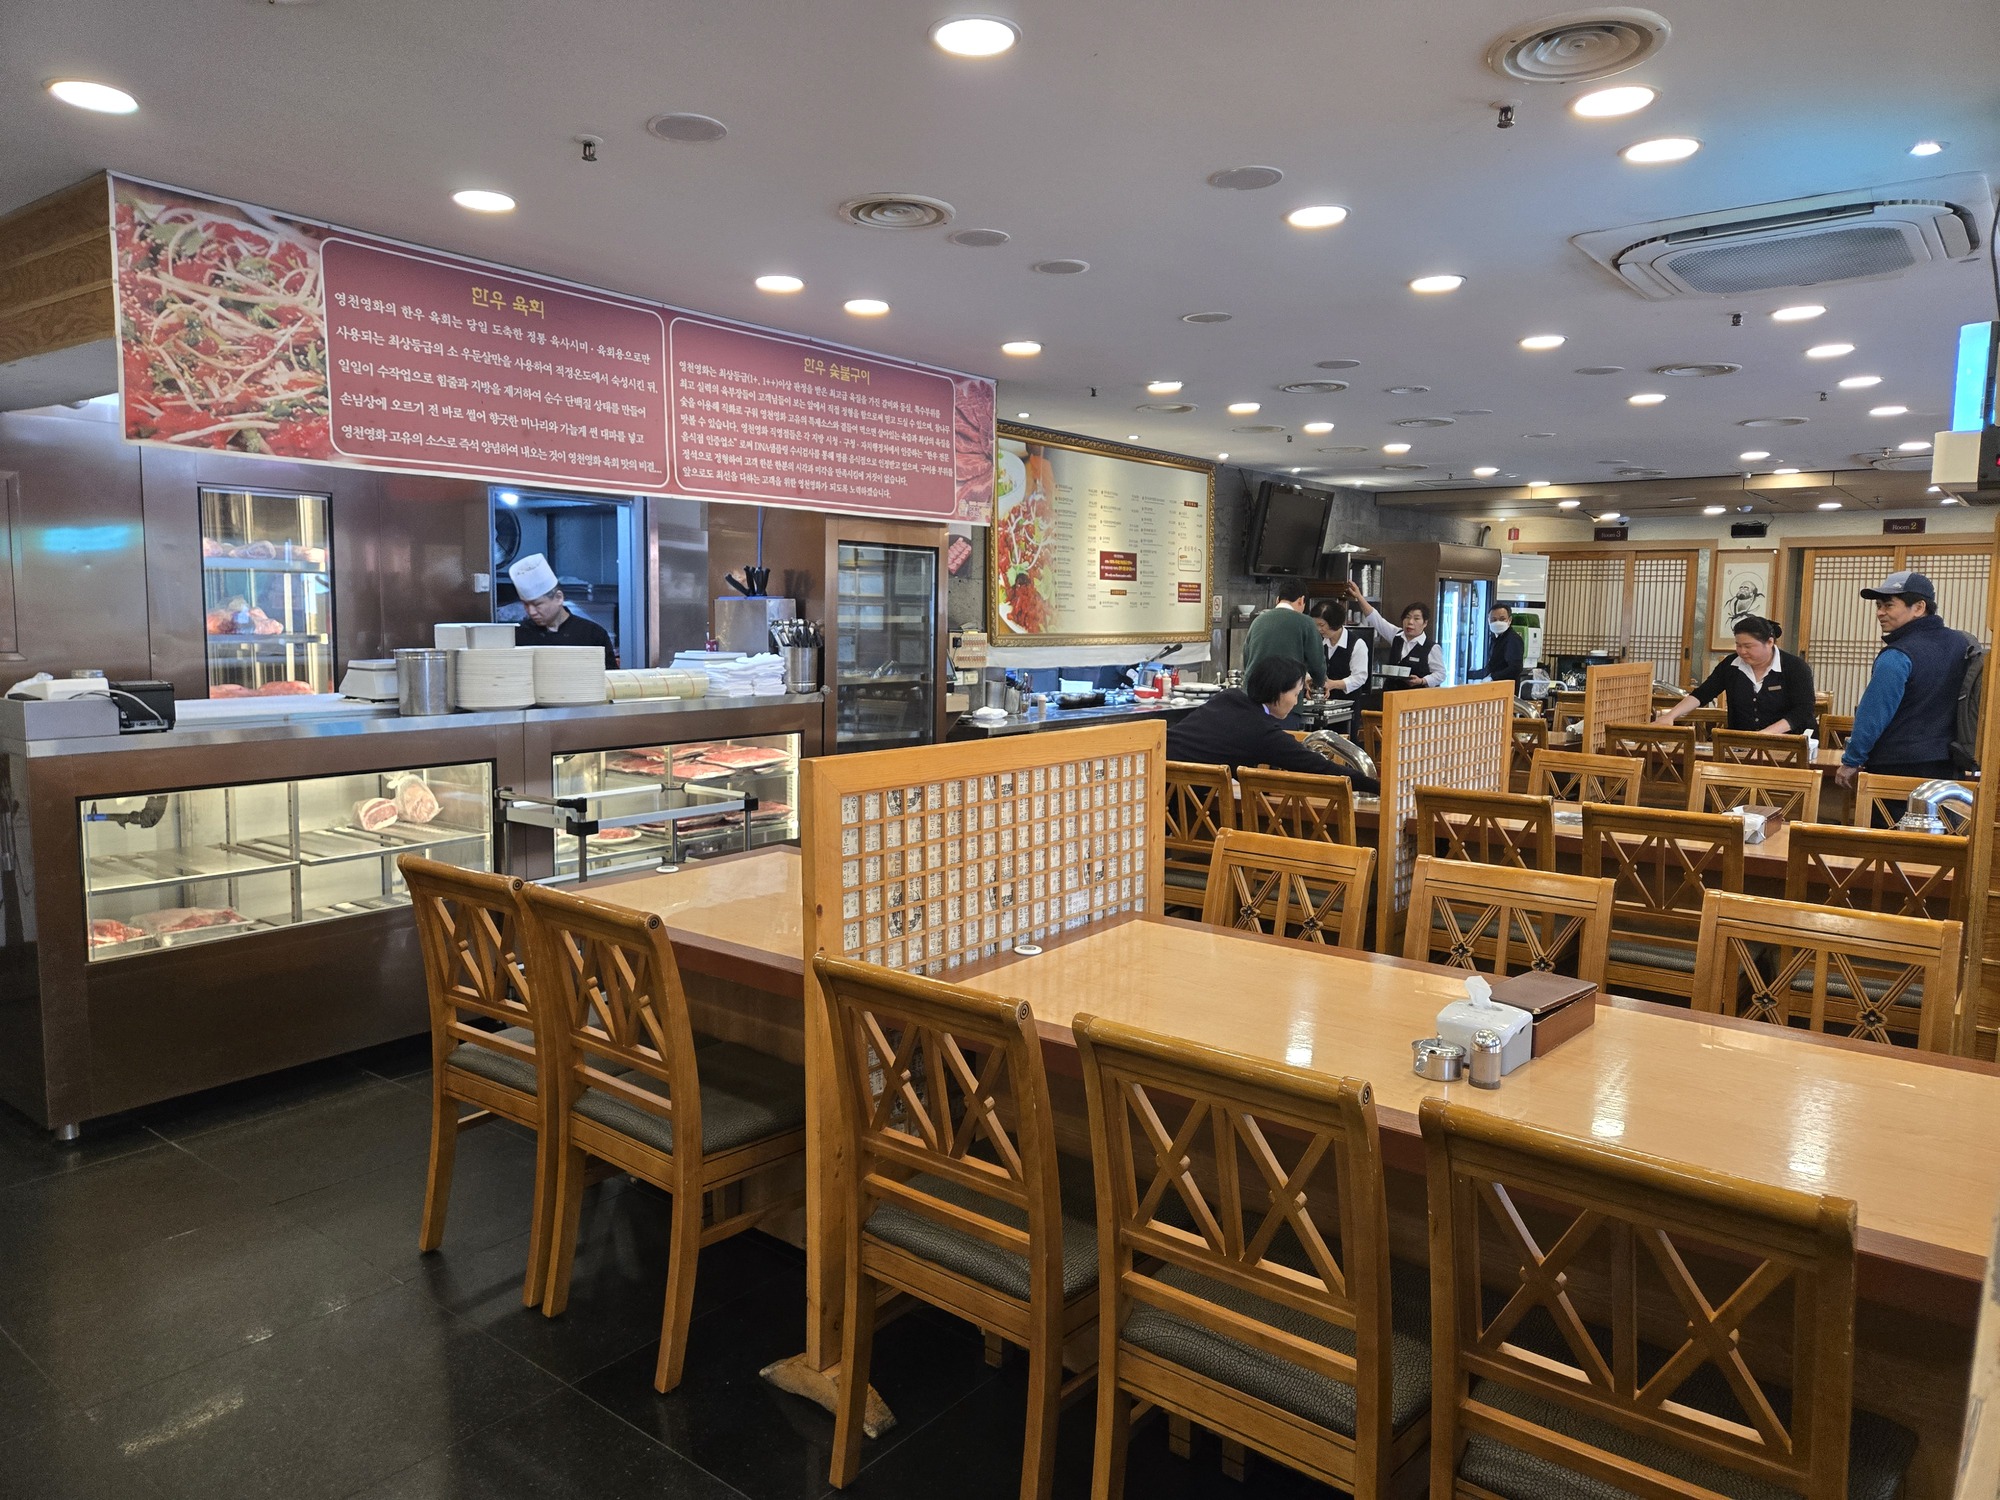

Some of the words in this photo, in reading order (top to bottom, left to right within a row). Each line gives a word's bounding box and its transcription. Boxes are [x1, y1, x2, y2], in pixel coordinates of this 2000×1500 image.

[471, 287, 507, 310] 한우
[512, 295, 544, 319] 육회
[334, 292, 397, 316] 영천영화의
[400, 305, 425, 321] 한우
[428, 311, 463, 329] 육회는
[466, 318, 488, 334] 당일
[491, 324, 523, 341] 도축한
[527, 330, 547, 345] 정통
[549, 335, 588, 354] 육사시미
[596, 344, 651, 365] 육회용으로만
[335, 325, 385, 346] 사용되는
[388, 334, 444, 356] 최상등급의
[446, 345, 459, 357] 소
[460, 347, 512, 368] 우둔살만을
[514, 357, 553, 375] 사용하여
[555, 365, 609, 385] 적정온도에서
[611, 375, 645, 392] 숙성시킨
[804, 357, 826, 376] 한우
[829, 363, 870, 385] 숯불구이
[338, 358, 374, 377] 일일이
[377, 365, 434, 384] 수작업으로
[436, 374, 469, 391] 힘줄과
[471, 379, 501, 396] 지방을
[503, 385, 541, 402] 제거하여
[543, 391, 563, 405] 순수
[564, 395, 592, 411] 단백질
[593, 399, 620, 415] 상태를
[621, 404, 646, 418] 만들어
[339, 392, 387, 411] 손님상에
[390, 399, 424, 415] 오르기
[428, 403, 439, 417] 전
[441, 405, 464, 419] 바로
[465, 408, 486, 423] 썰어
[488, 412, 519, 428] 향긋한
[520, 417, 559, 433] 미나리와
[560, 422, 587, 437] 가늘게
[589, 426, 598, 439] 썬
[600, 428, 626, 443] 대파를
[627, 432, 644, 444] 넣고
[341, 425, 388, 442] 영천영화
[389, 431, 423, 446] 고유의
[425, 435, 458, 448] 소스로
[458, 438, 479, 452] 즉석
[480, 440, 519, 457] 양념하여
[520, 445, 548, 461] 내오는
[548, 449, 566, 463] 것이
[567, 452, 602, 467] 영천영화
[602, 456, 619, 469] 육회
[620, 458, 638, 471] 맛의
[1615, 530, 1621, 538] 3
[1910, 521, 1917, 530] 2
